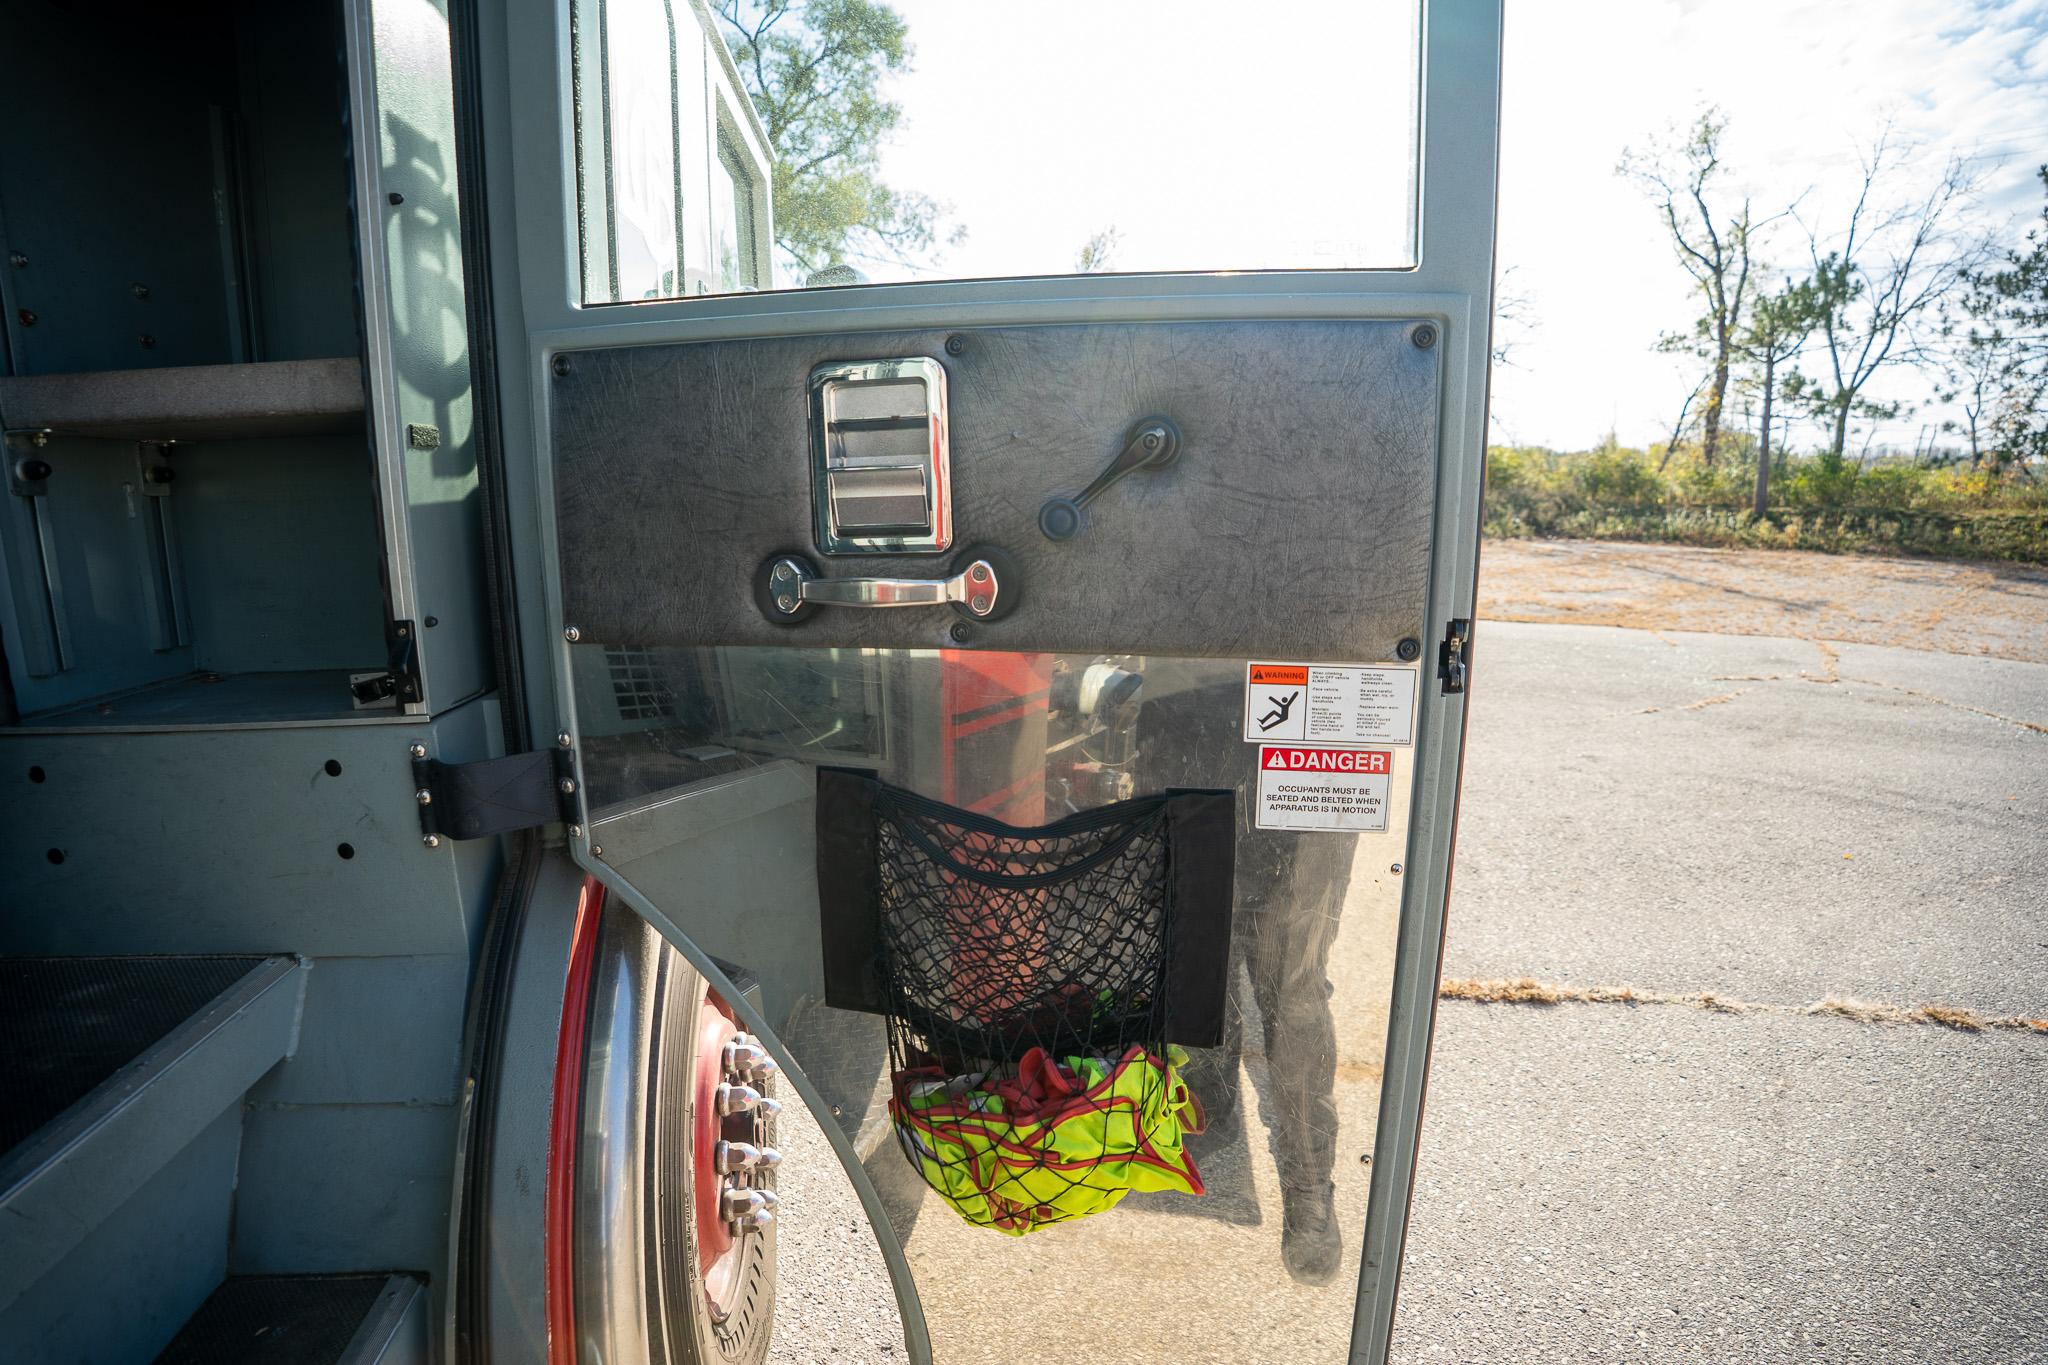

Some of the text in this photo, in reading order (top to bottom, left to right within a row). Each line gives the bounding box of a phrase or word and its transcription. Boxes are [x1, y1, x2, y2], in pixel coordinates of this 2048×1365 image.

[1264, 672, 1304, 680] WARNING
[1290, 751, 1385, 770] DANGER
[1278, 785, 1330, 794] OCCUPANTS
[1266, 794, 1298, 802] SEATED
[1270, 804, 1319, 812] APPARATUS
[1342, 806, 1377, 814] MOTION
